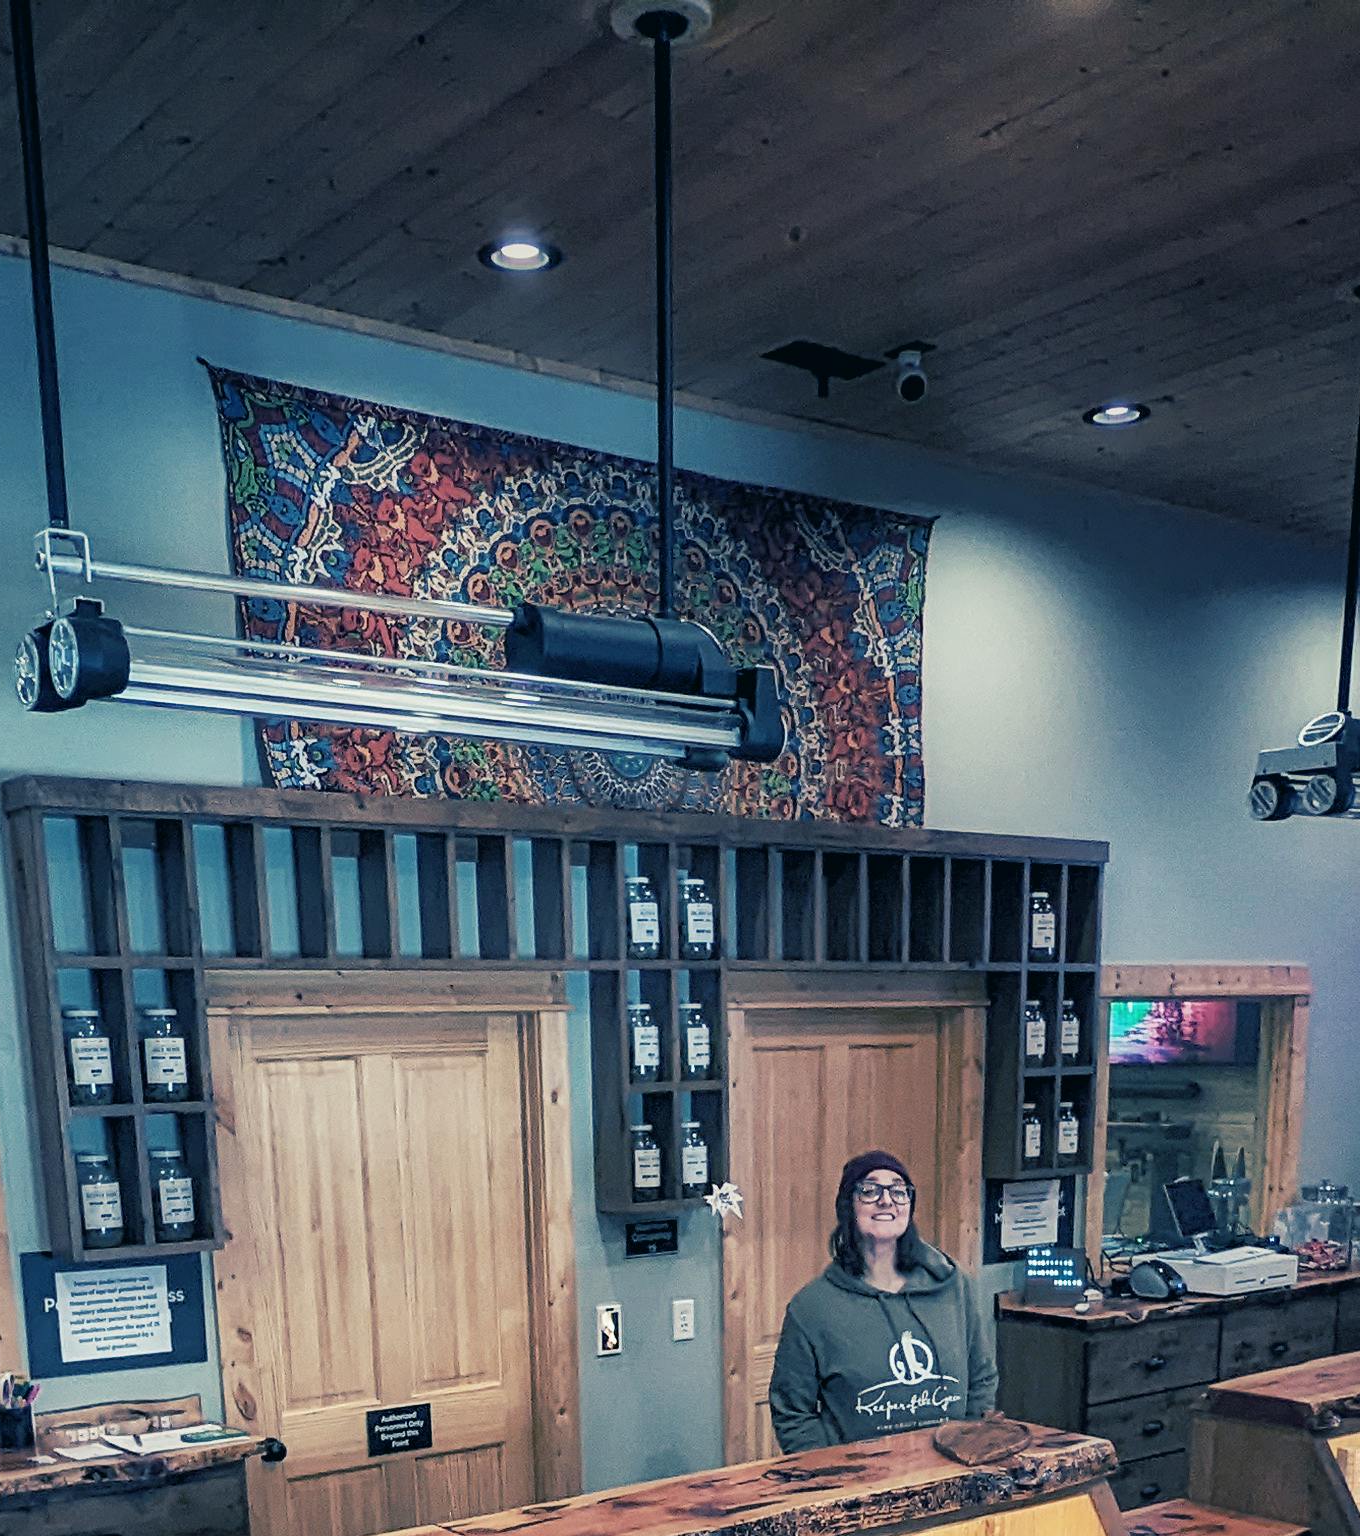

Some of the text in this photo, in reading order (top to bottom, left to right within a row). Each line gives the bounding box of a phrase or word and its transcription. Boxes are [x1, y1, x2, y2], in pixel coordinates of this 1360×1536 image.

[855, 1390, 906, 1420] Keeper
[380, 1411, 418, 1424] Authorized
[374, 1419, 425, 1433] Personnel Only
[380, 1430, 407, 1442] Beyond
